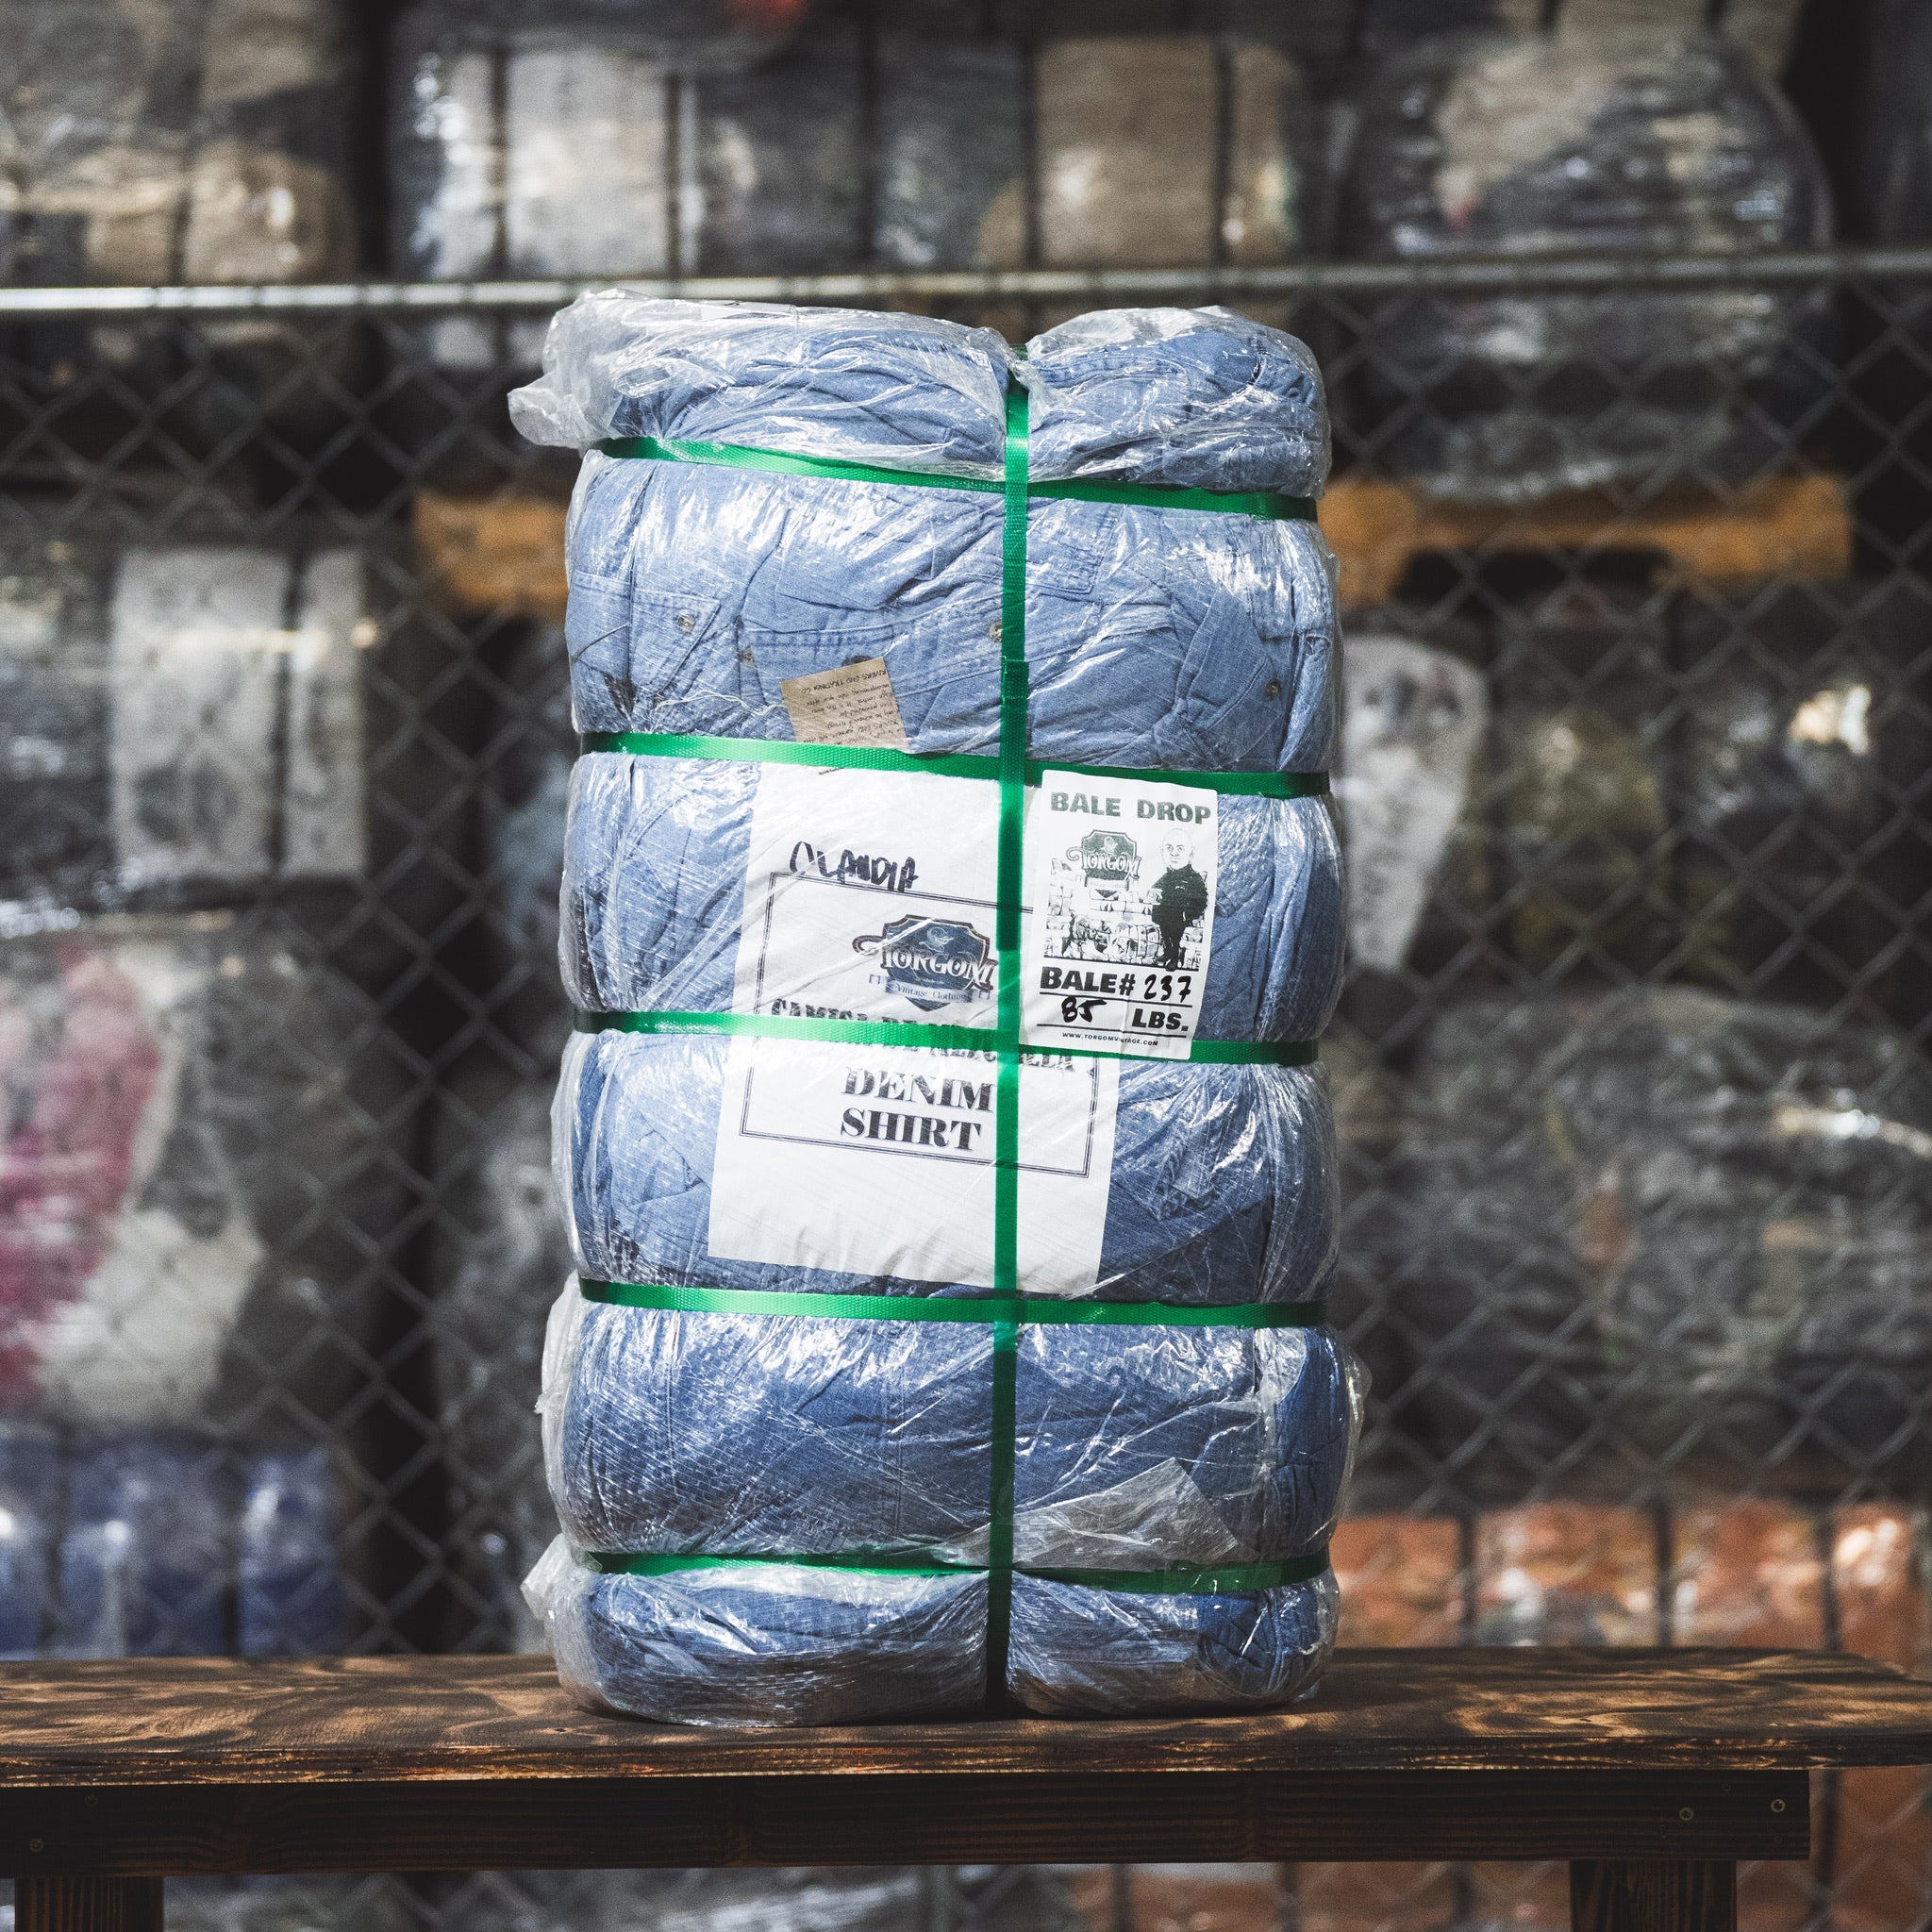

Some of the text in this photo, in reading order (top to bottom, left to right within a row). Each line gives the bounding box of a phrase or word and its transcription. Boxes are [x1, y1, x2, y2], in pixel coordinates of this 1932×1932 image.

[845, 675, 859, 684] END
[861, 669, 886, 679] RIVERS
[1051, 792, 1211, 824] BALE DROP
[1066, 847, 1142, 879] TORGOM
[853, 936, 998, 991] TORGOM
[895, 983, 928, 998] Vintage
[1144, 974, 1191, 1003] 237
[1061, 995, 1189, 1032] 85 LBS.
[1062, 1032, 1158, 1046] WWW.TORGOMVTAGE.COM
[841, 1067, 996, 1112] DENIM
[841, 1108, 981, 1151] SHIRT
